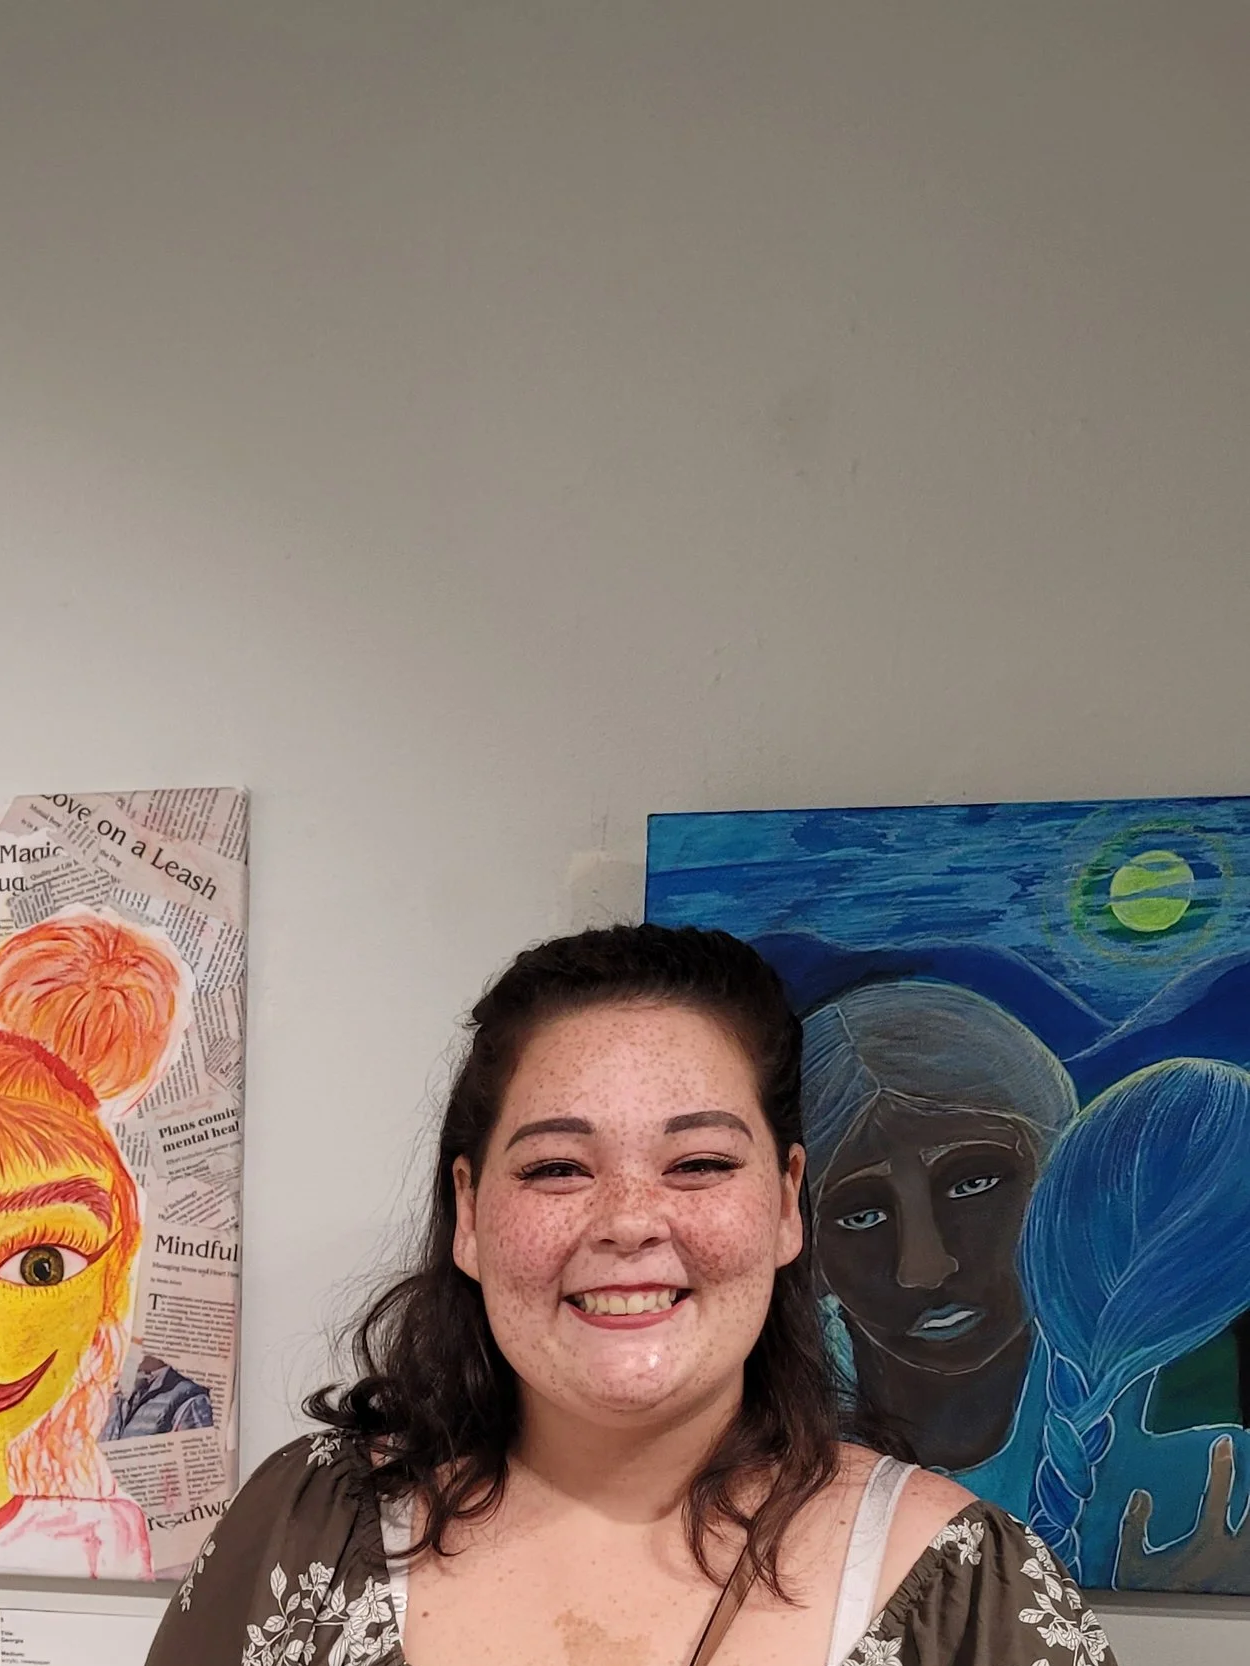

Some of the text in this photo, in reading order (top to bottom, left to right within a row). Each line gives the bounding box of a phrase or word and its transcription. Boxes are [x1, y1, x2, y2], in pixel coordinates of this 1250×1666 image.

[97, 820, 127, 847] on
[131, 840, 148, 860] a
[151, 847, 218, 900] Leash
[159, 1121, 196, 1139] Plans
[162, 1131, 210, 1153] mental
[154, 1234, 239, 1262] Mindful
